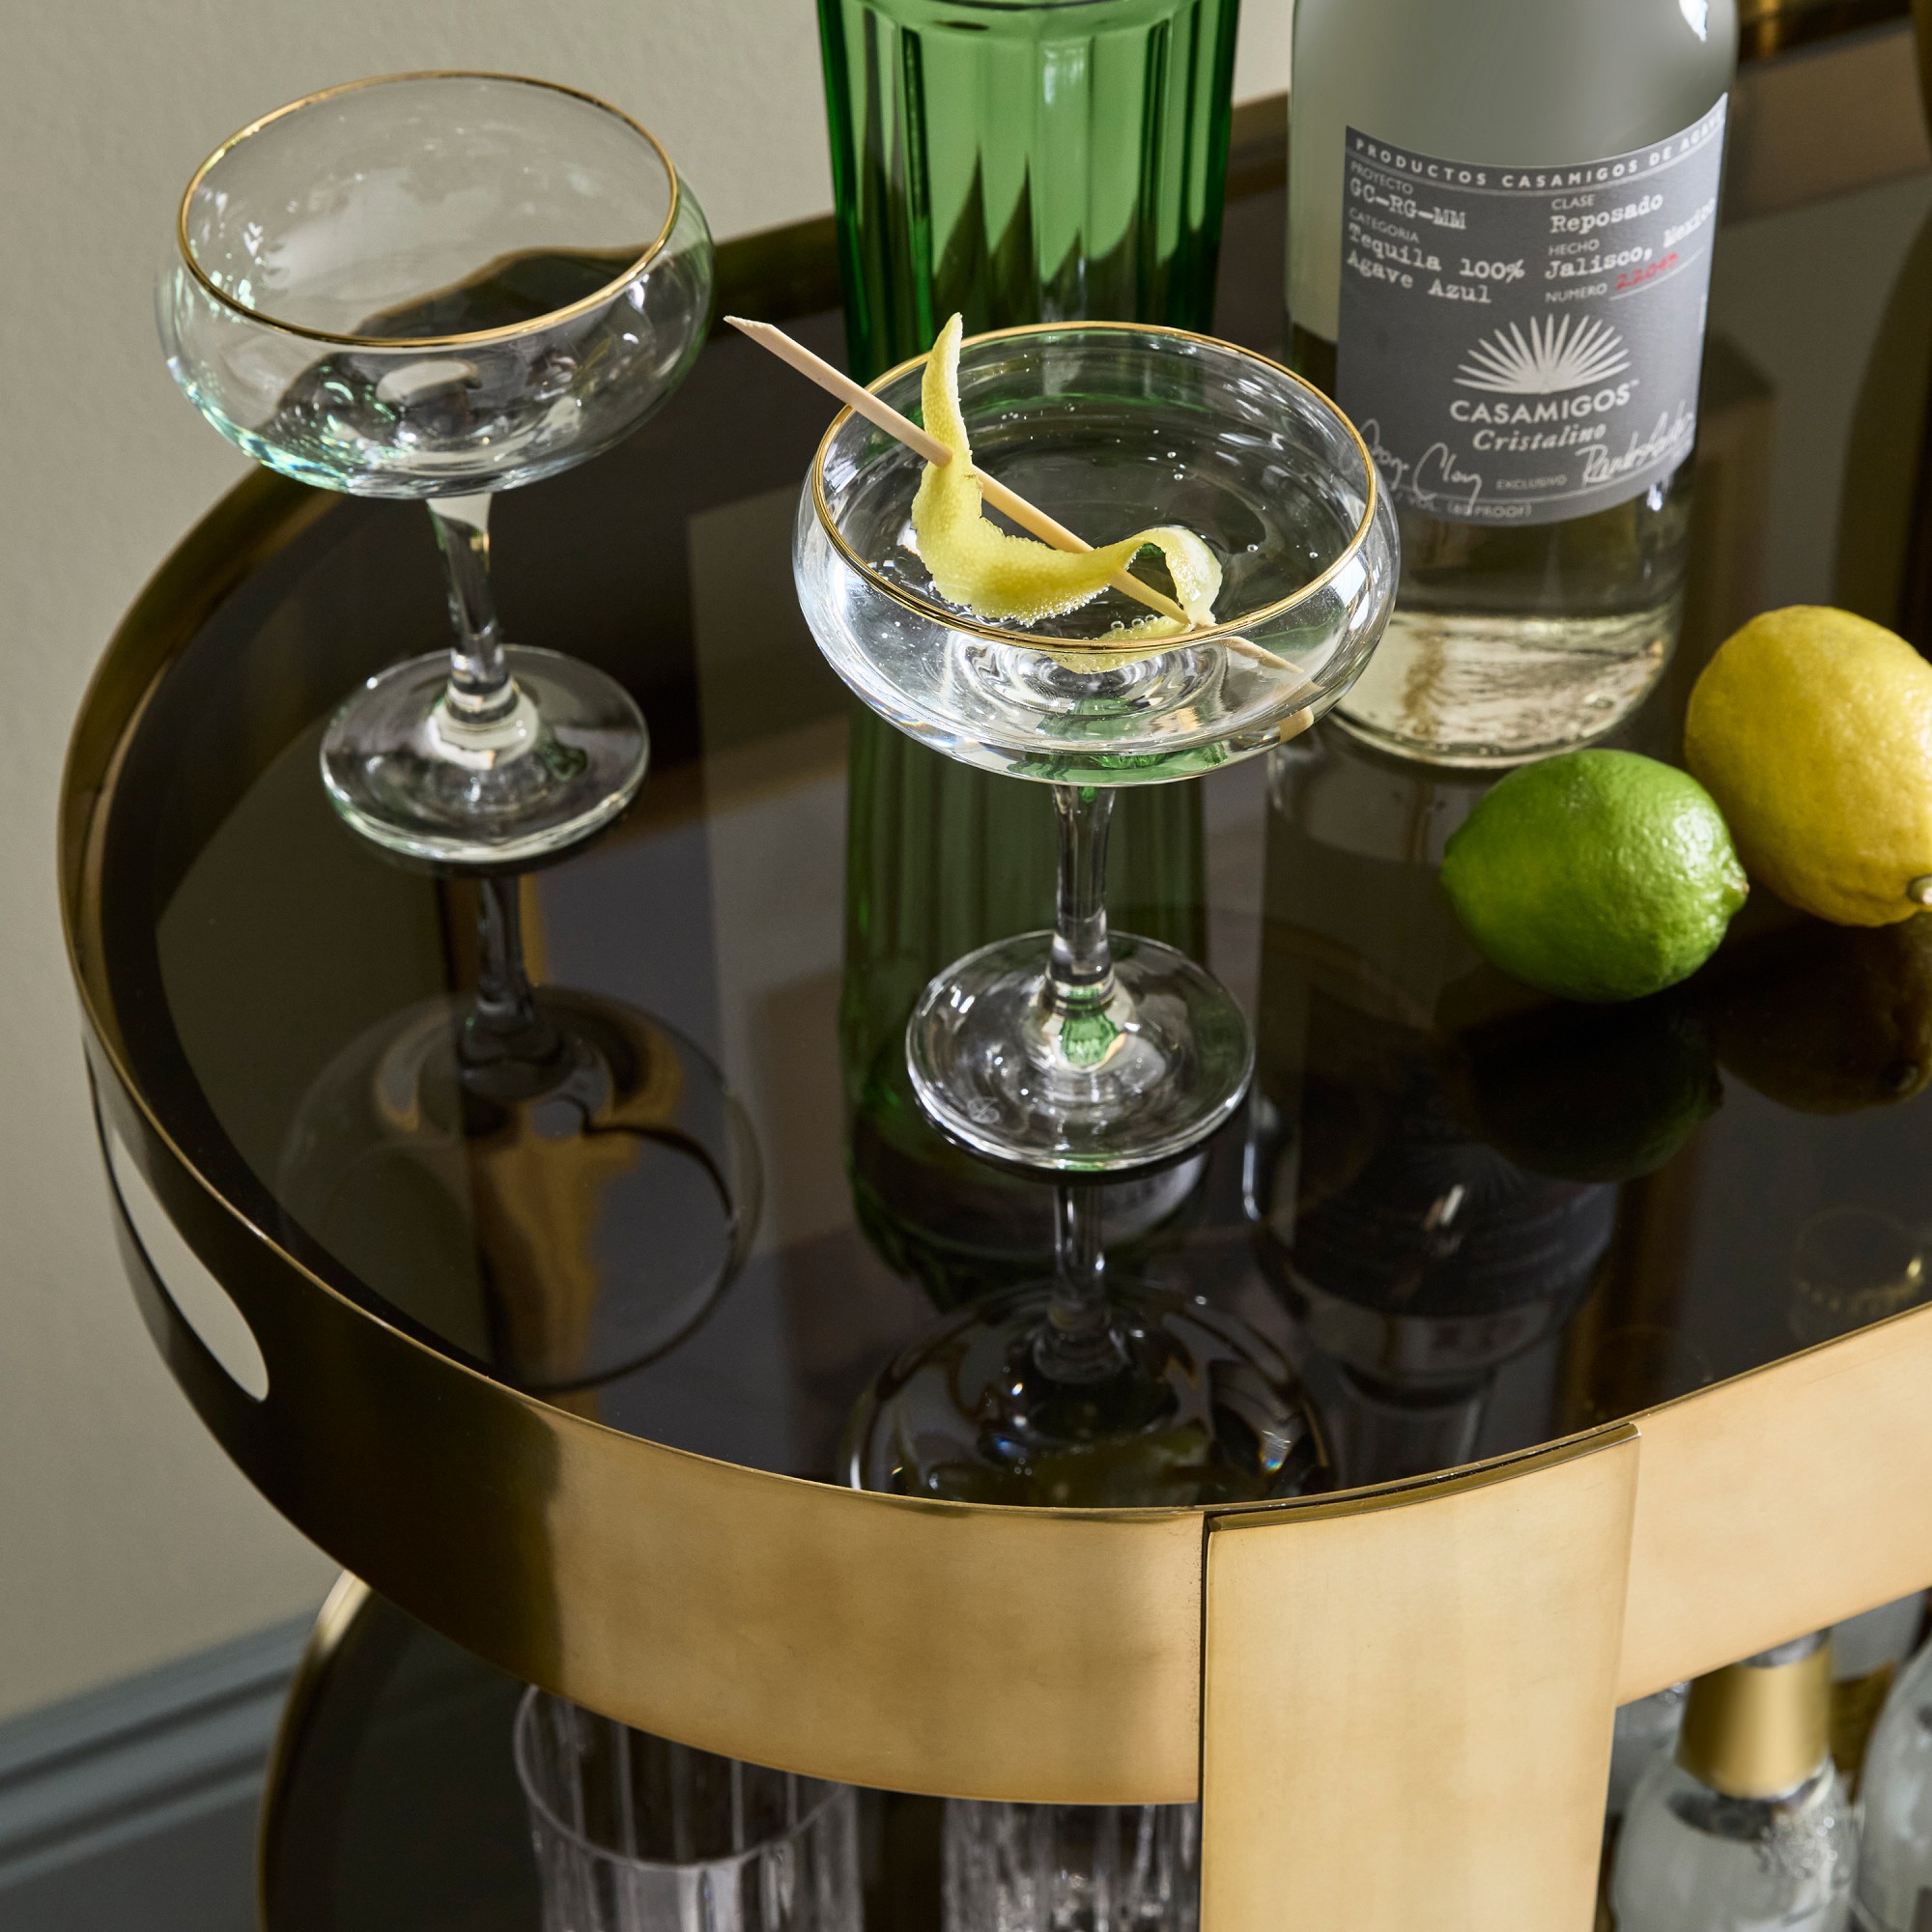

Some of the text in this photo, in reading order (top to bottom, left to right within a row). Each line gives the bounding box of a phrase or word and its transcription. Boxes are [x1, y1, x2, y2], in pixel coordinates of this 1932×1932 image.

[1350, 160, 1414, 195] PROYECTO
[1355, 138, 1487, 185] PRODUCTOS
[1501, 159, 1638, 188] CASAMIGOS
[1648, 146, 1672, 167] DE
[1549, 194, 1663, 234] Reposado
[1550, 193, 1595, 211] CLASE
[1349, 207, 1420, 243] CATEGORIA
[1348, 222, 1526, 283] Tequila 100%
[1545, 246, 1653, 280] Jalisco,
[1548, 239, 1600, 256] HECHO
[1346, 248, 1492, 304] Agave Azul
[1546, 282, 1607, 304] NUMERO
[1450, 383, 1631, 425] CASAMIGOS
[1472, 423, 1606, 452] Cristalino
